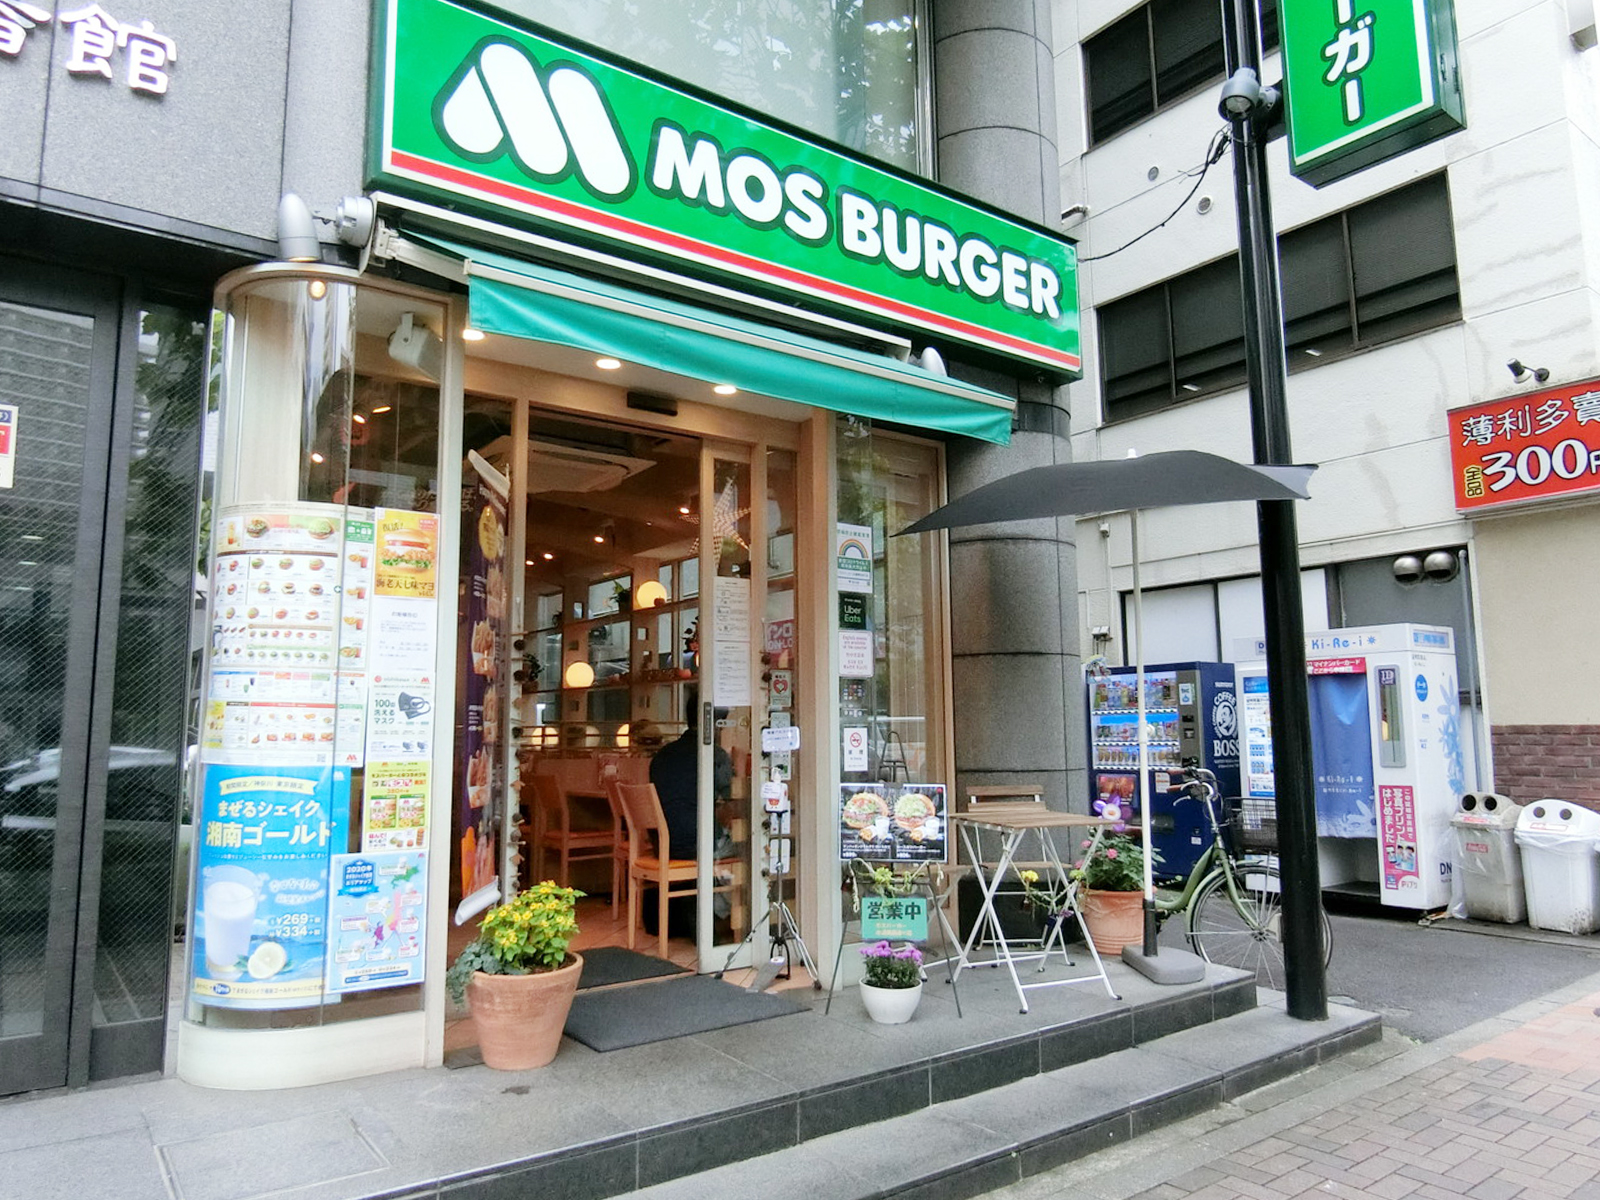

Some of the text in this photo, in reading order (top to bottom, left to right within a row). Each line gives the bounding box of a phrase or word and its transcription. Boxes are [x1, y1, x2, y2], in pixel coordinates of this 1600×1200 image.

[652, 125, 1061, 320] MOS BURGER
[844, 605, 862, 615] Uber
[844, 614, 862, 623] Eats
[1312, 636, 1363, 650] Ki-Re-i
[218, 799, 321, 818] まぜるシェイク
[1382, 788, 1396, 844] はじめました
[206, 820, 338, 848] 湘南ゴールド
[867, 901, 922, 920] 営業中
